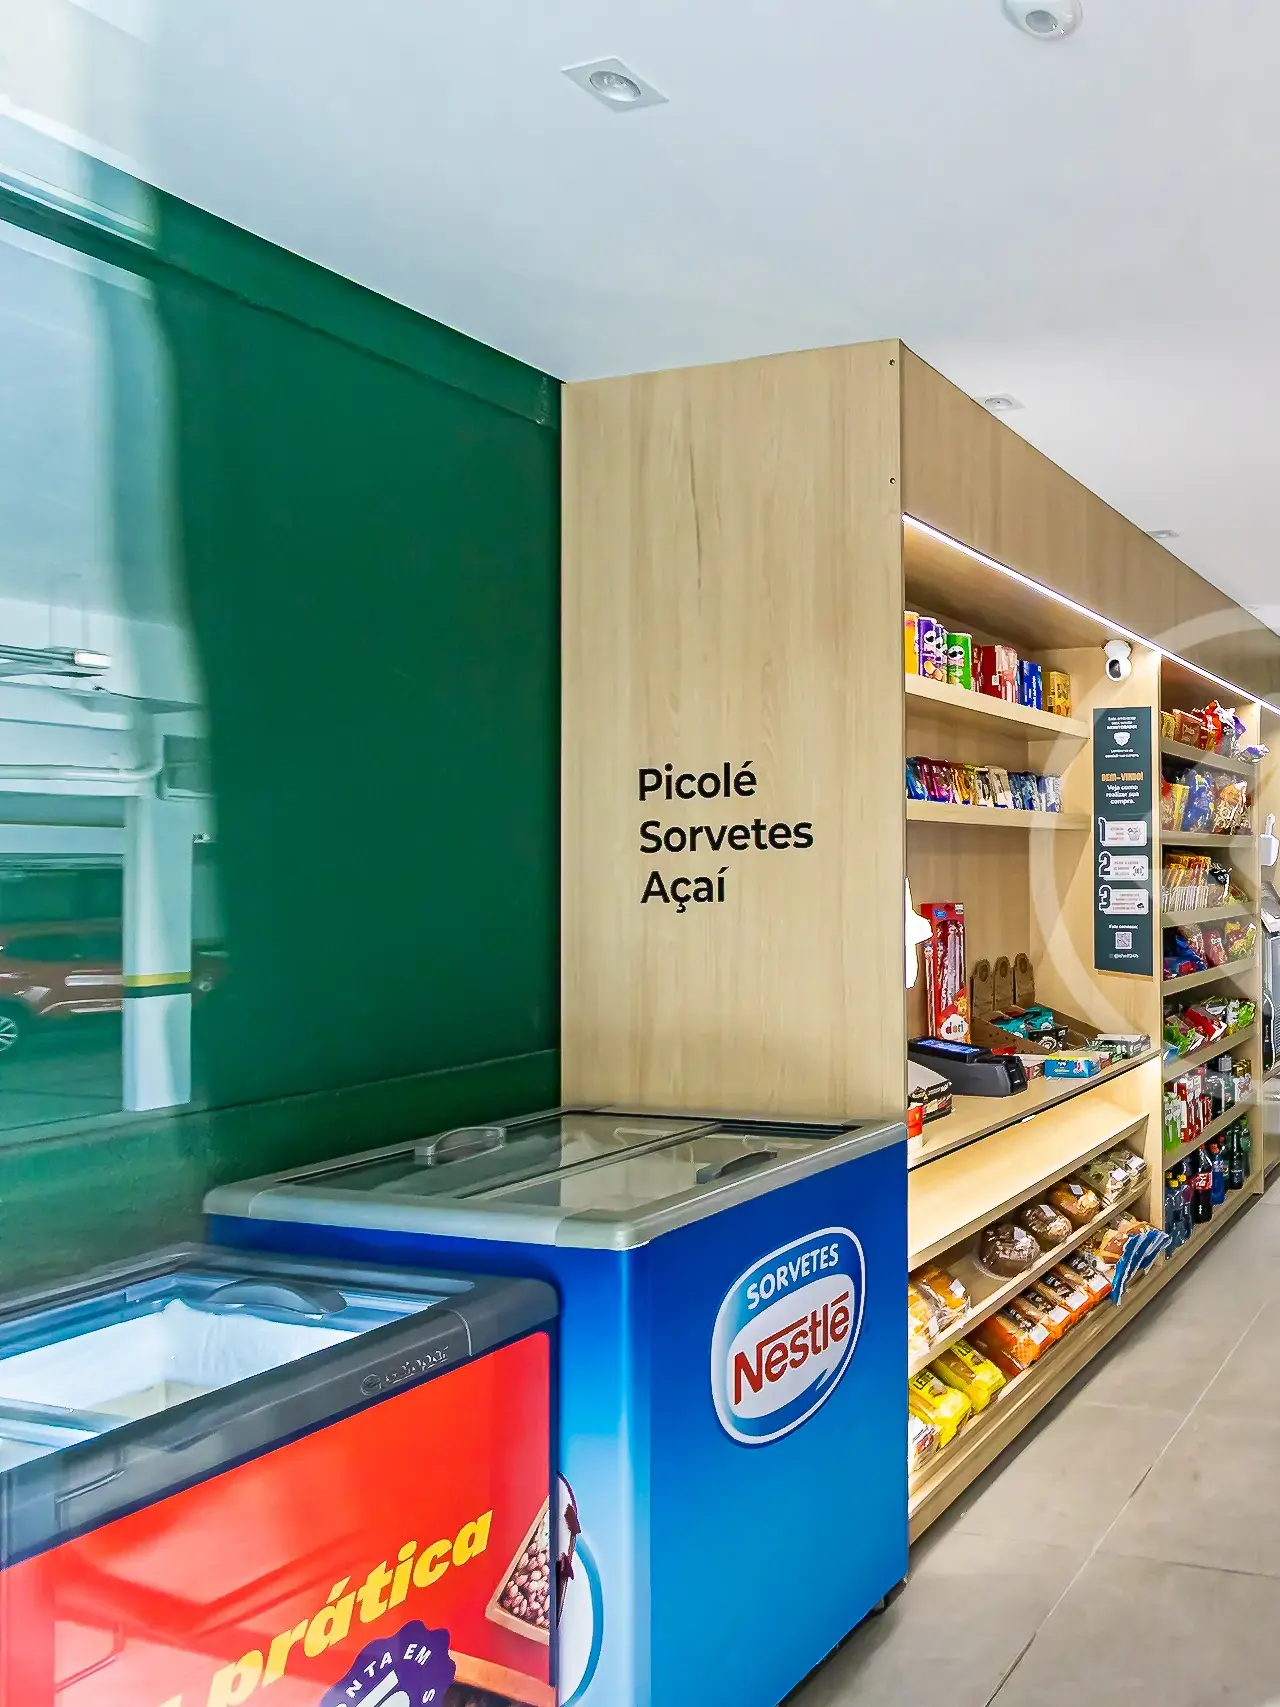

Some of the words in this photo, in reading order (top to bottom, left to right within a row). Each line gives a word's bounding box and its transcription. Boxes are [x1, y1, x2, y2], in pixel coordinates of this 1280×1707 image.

[638, 760, 758, 801] Picolé
[639, 818, 815, 854] Sorvetes
[1100, 852, 1111, 876] 2
[640, 866, 730, 914] Açaí
[1099, 886, 1111, 909] 3
[746, 1243, 839, 1310] SORVETES
[734, 1290, 850, 1406] Nestlé
[206, 1509, 494, 1707] prática
[402, 1643, 432, 1666] EM
